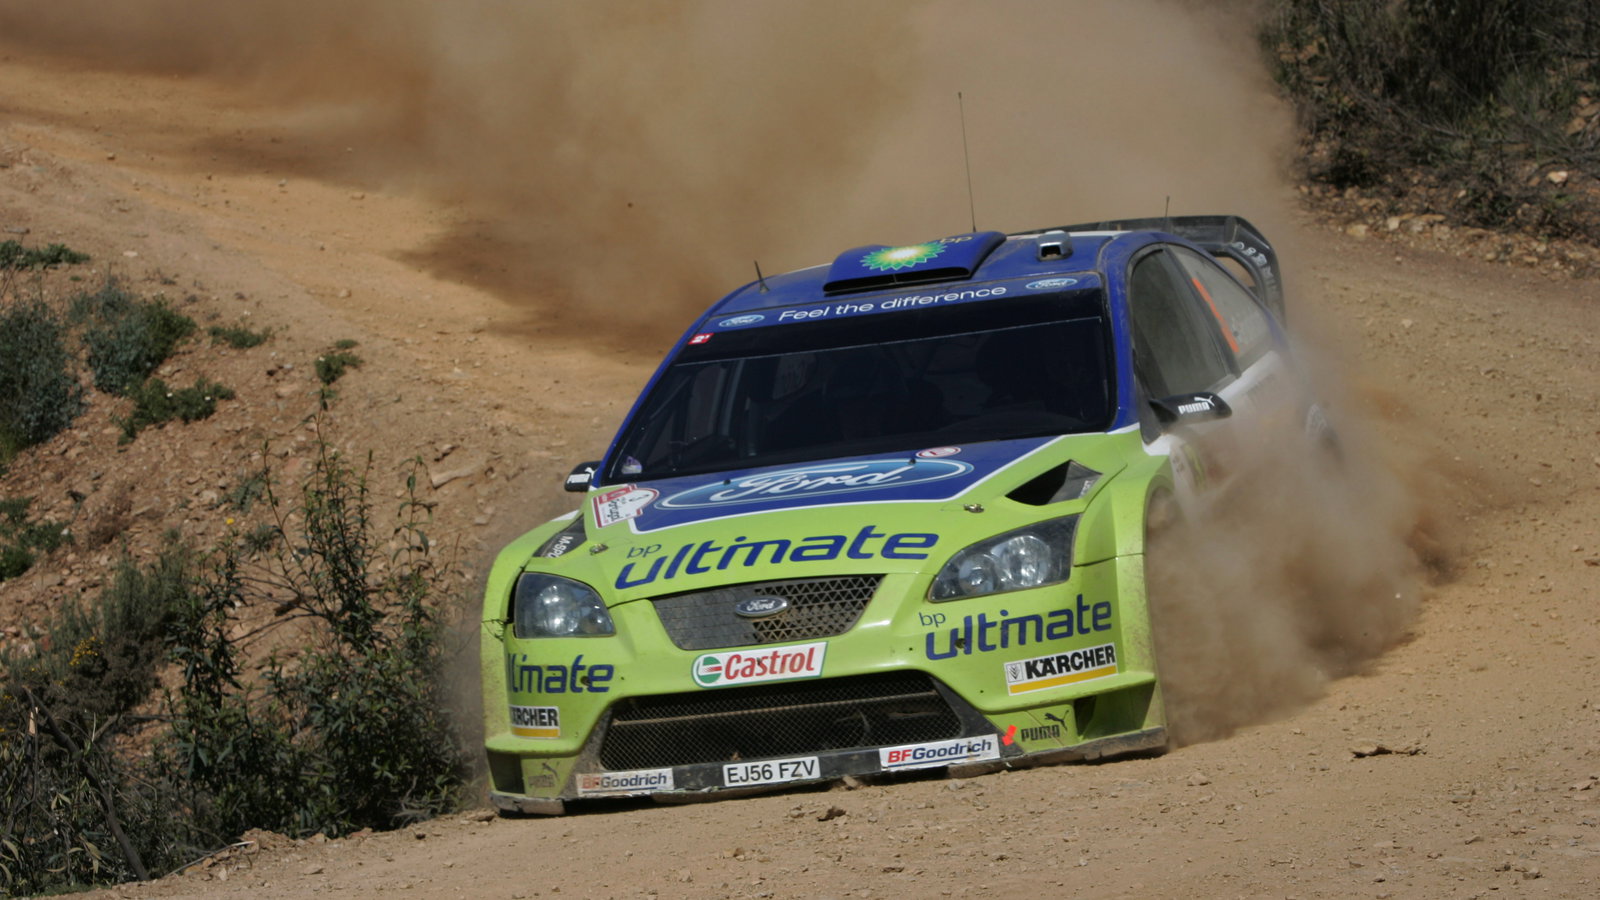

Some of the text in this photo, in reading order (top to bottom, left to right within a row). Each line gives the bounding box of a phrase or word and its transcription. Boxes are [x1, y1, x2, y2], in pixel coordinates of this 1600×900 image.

[778, 286, 1007, 322] Feel the difference
[1178, 401, 1211, 415] PUMA
[709, 466, 915, 501] Ford
[615, 525, 939, 589] ultimate
[627, 543, 662, 558] bp
[746, 599, 776, 611] Ford
[918, 612, 946, 628] bp
[925, 594, 1112, 661] ultimate
[724, 647, 815, 680] Castrol
[1025, 645, 1116, 680] KÄRCHER
[1020, 724, 1061, 743] PUMA
[887, 738, 992, 764] BFGoodrich
[582, 773, 667, 789] BFGoodrich
[727, 760, 815, 784] EJ56 FZV
